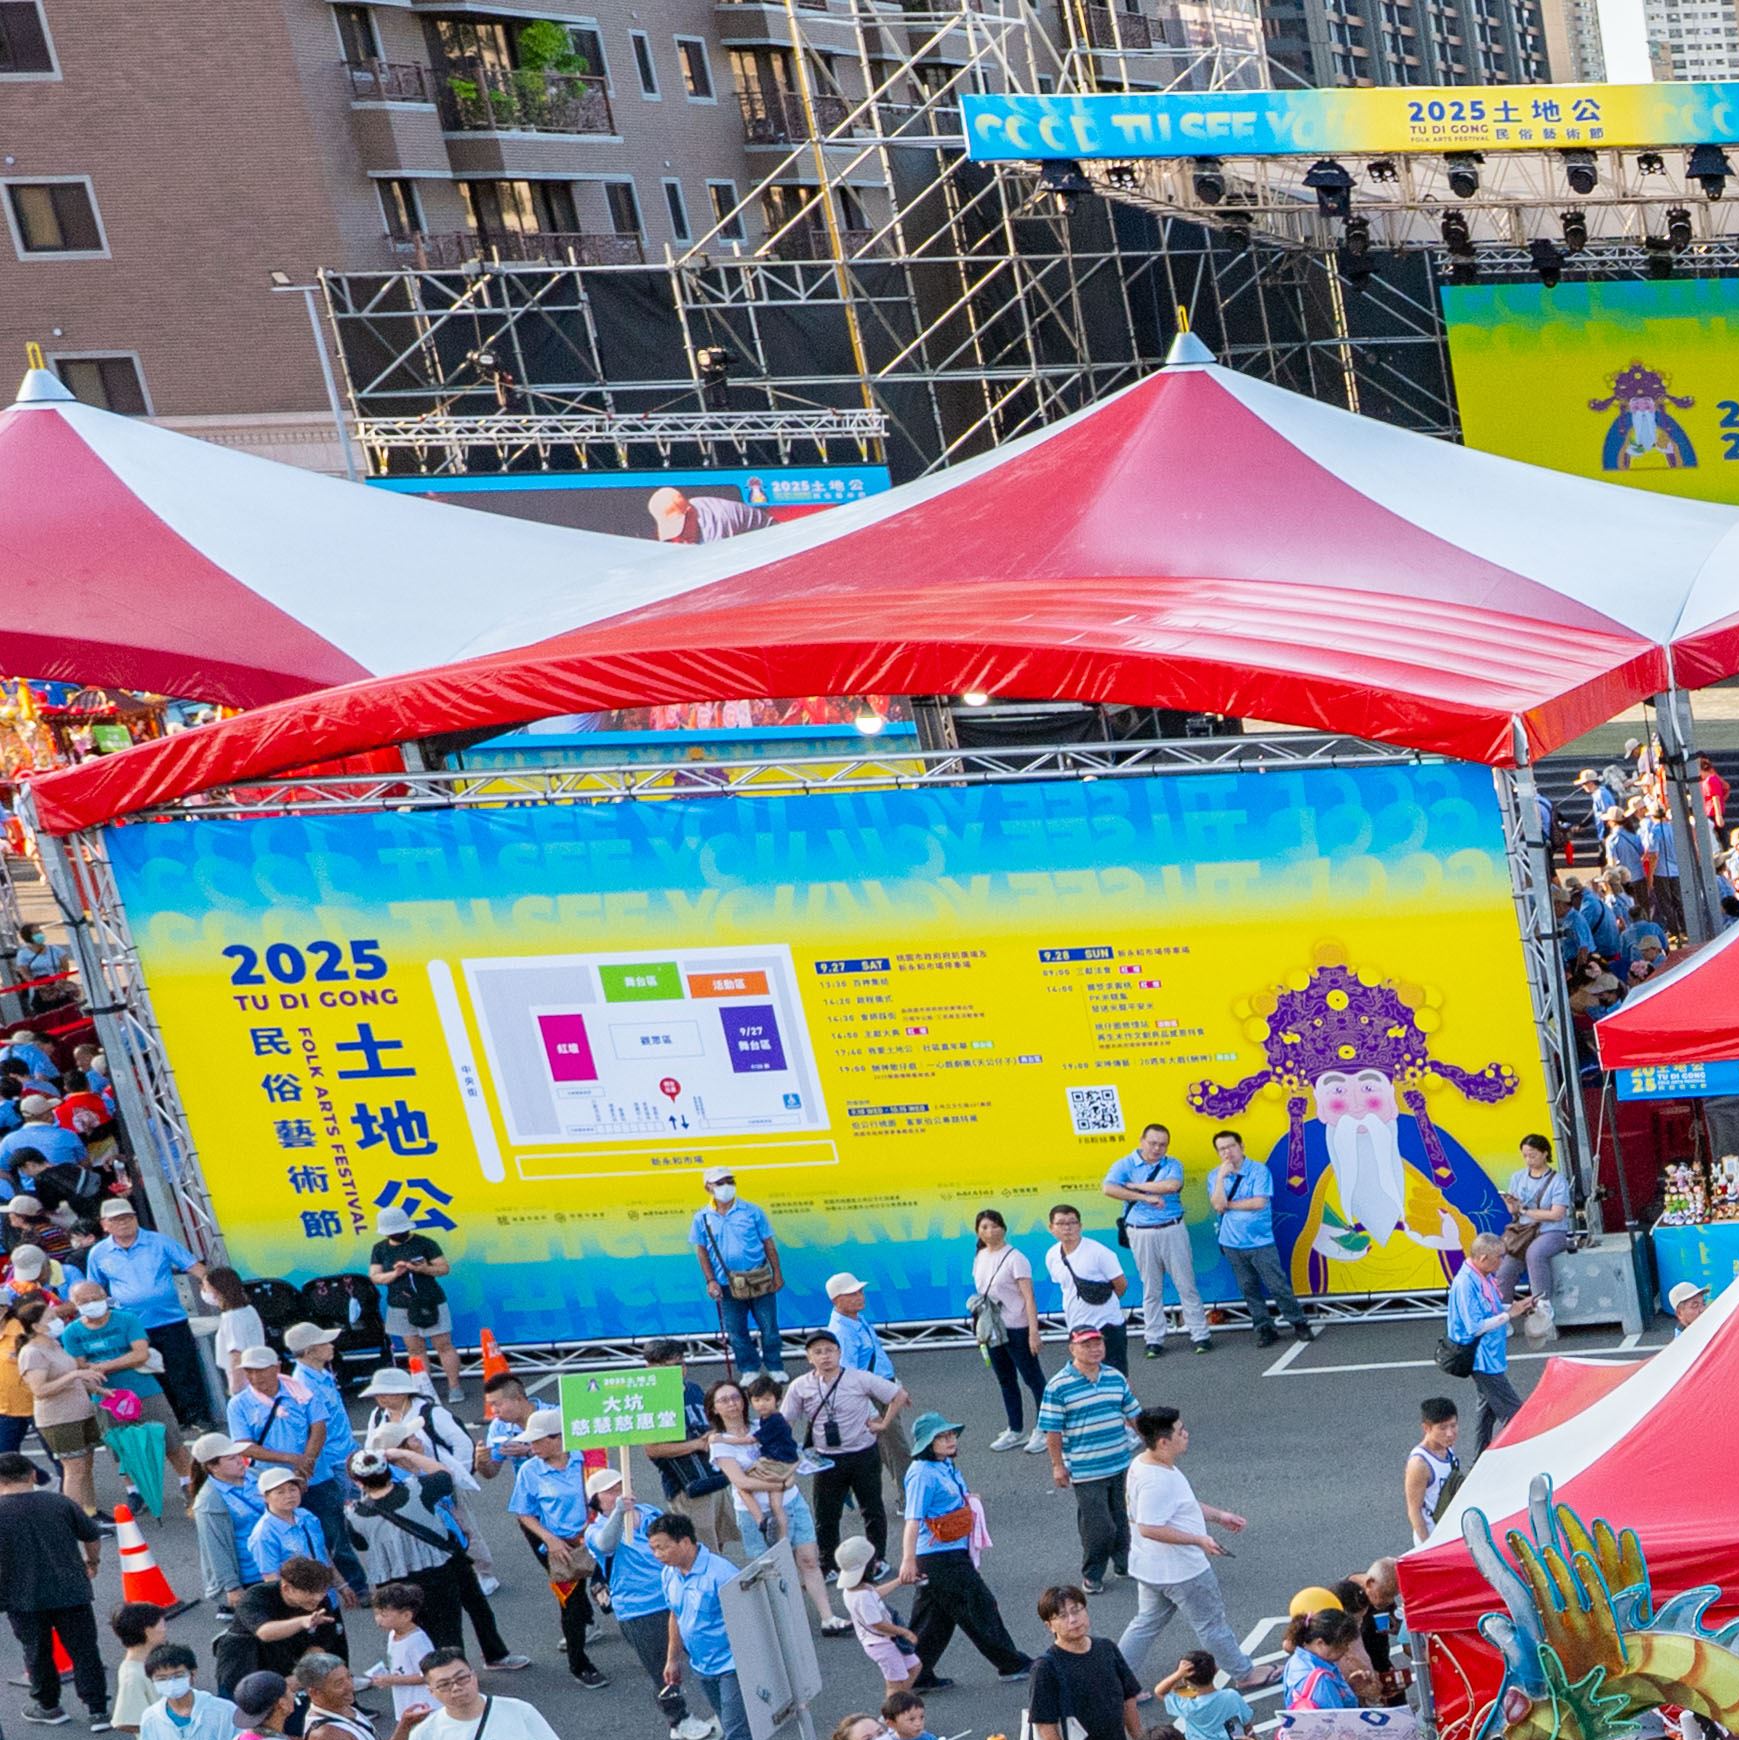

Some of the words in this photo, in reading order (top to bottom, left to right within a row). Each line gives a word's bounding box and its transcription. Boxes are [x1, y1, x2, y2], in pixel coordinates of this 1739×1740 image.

[1408, 100, 1486, 122] 2025
[1492, 98, 1602, 123] 土地公
[1410, 125, 1428, 135] TU
[1431, 124, 1446, 135] DI
[1450, 123, 1489, 134] GONG
[1496, 127, 1604, 141] 民俗藝術節
[771, 479, 811, 492] 2025
[811, 478, 865, 492] 土地公
[222, 939, 388, 986] 2025
[1043, 951, 1070, 962] 9.28
[1084, 948, 1110, 959] SUN
[819, 962, 846, 974] 9.27
[861, 959, 884, 972] SAT
[233, 994, 270, 1012] TU
[279, 992, 310, 1010] DI
[319, 988, 399, 1008] GONG
[738, 1025, 764, 1037] 9/27
[249, 1026, 344, 1239] 民俗藝術節
[298, 1026, 324, 1079] FOLK
[314, 1085, 341, 1137] ARTS
[330, 1144, 369, 1236] FESTIVAL
[335, 1022, 458, 1233] 土地公
[602, 1393, 645, 1414] 大坑
